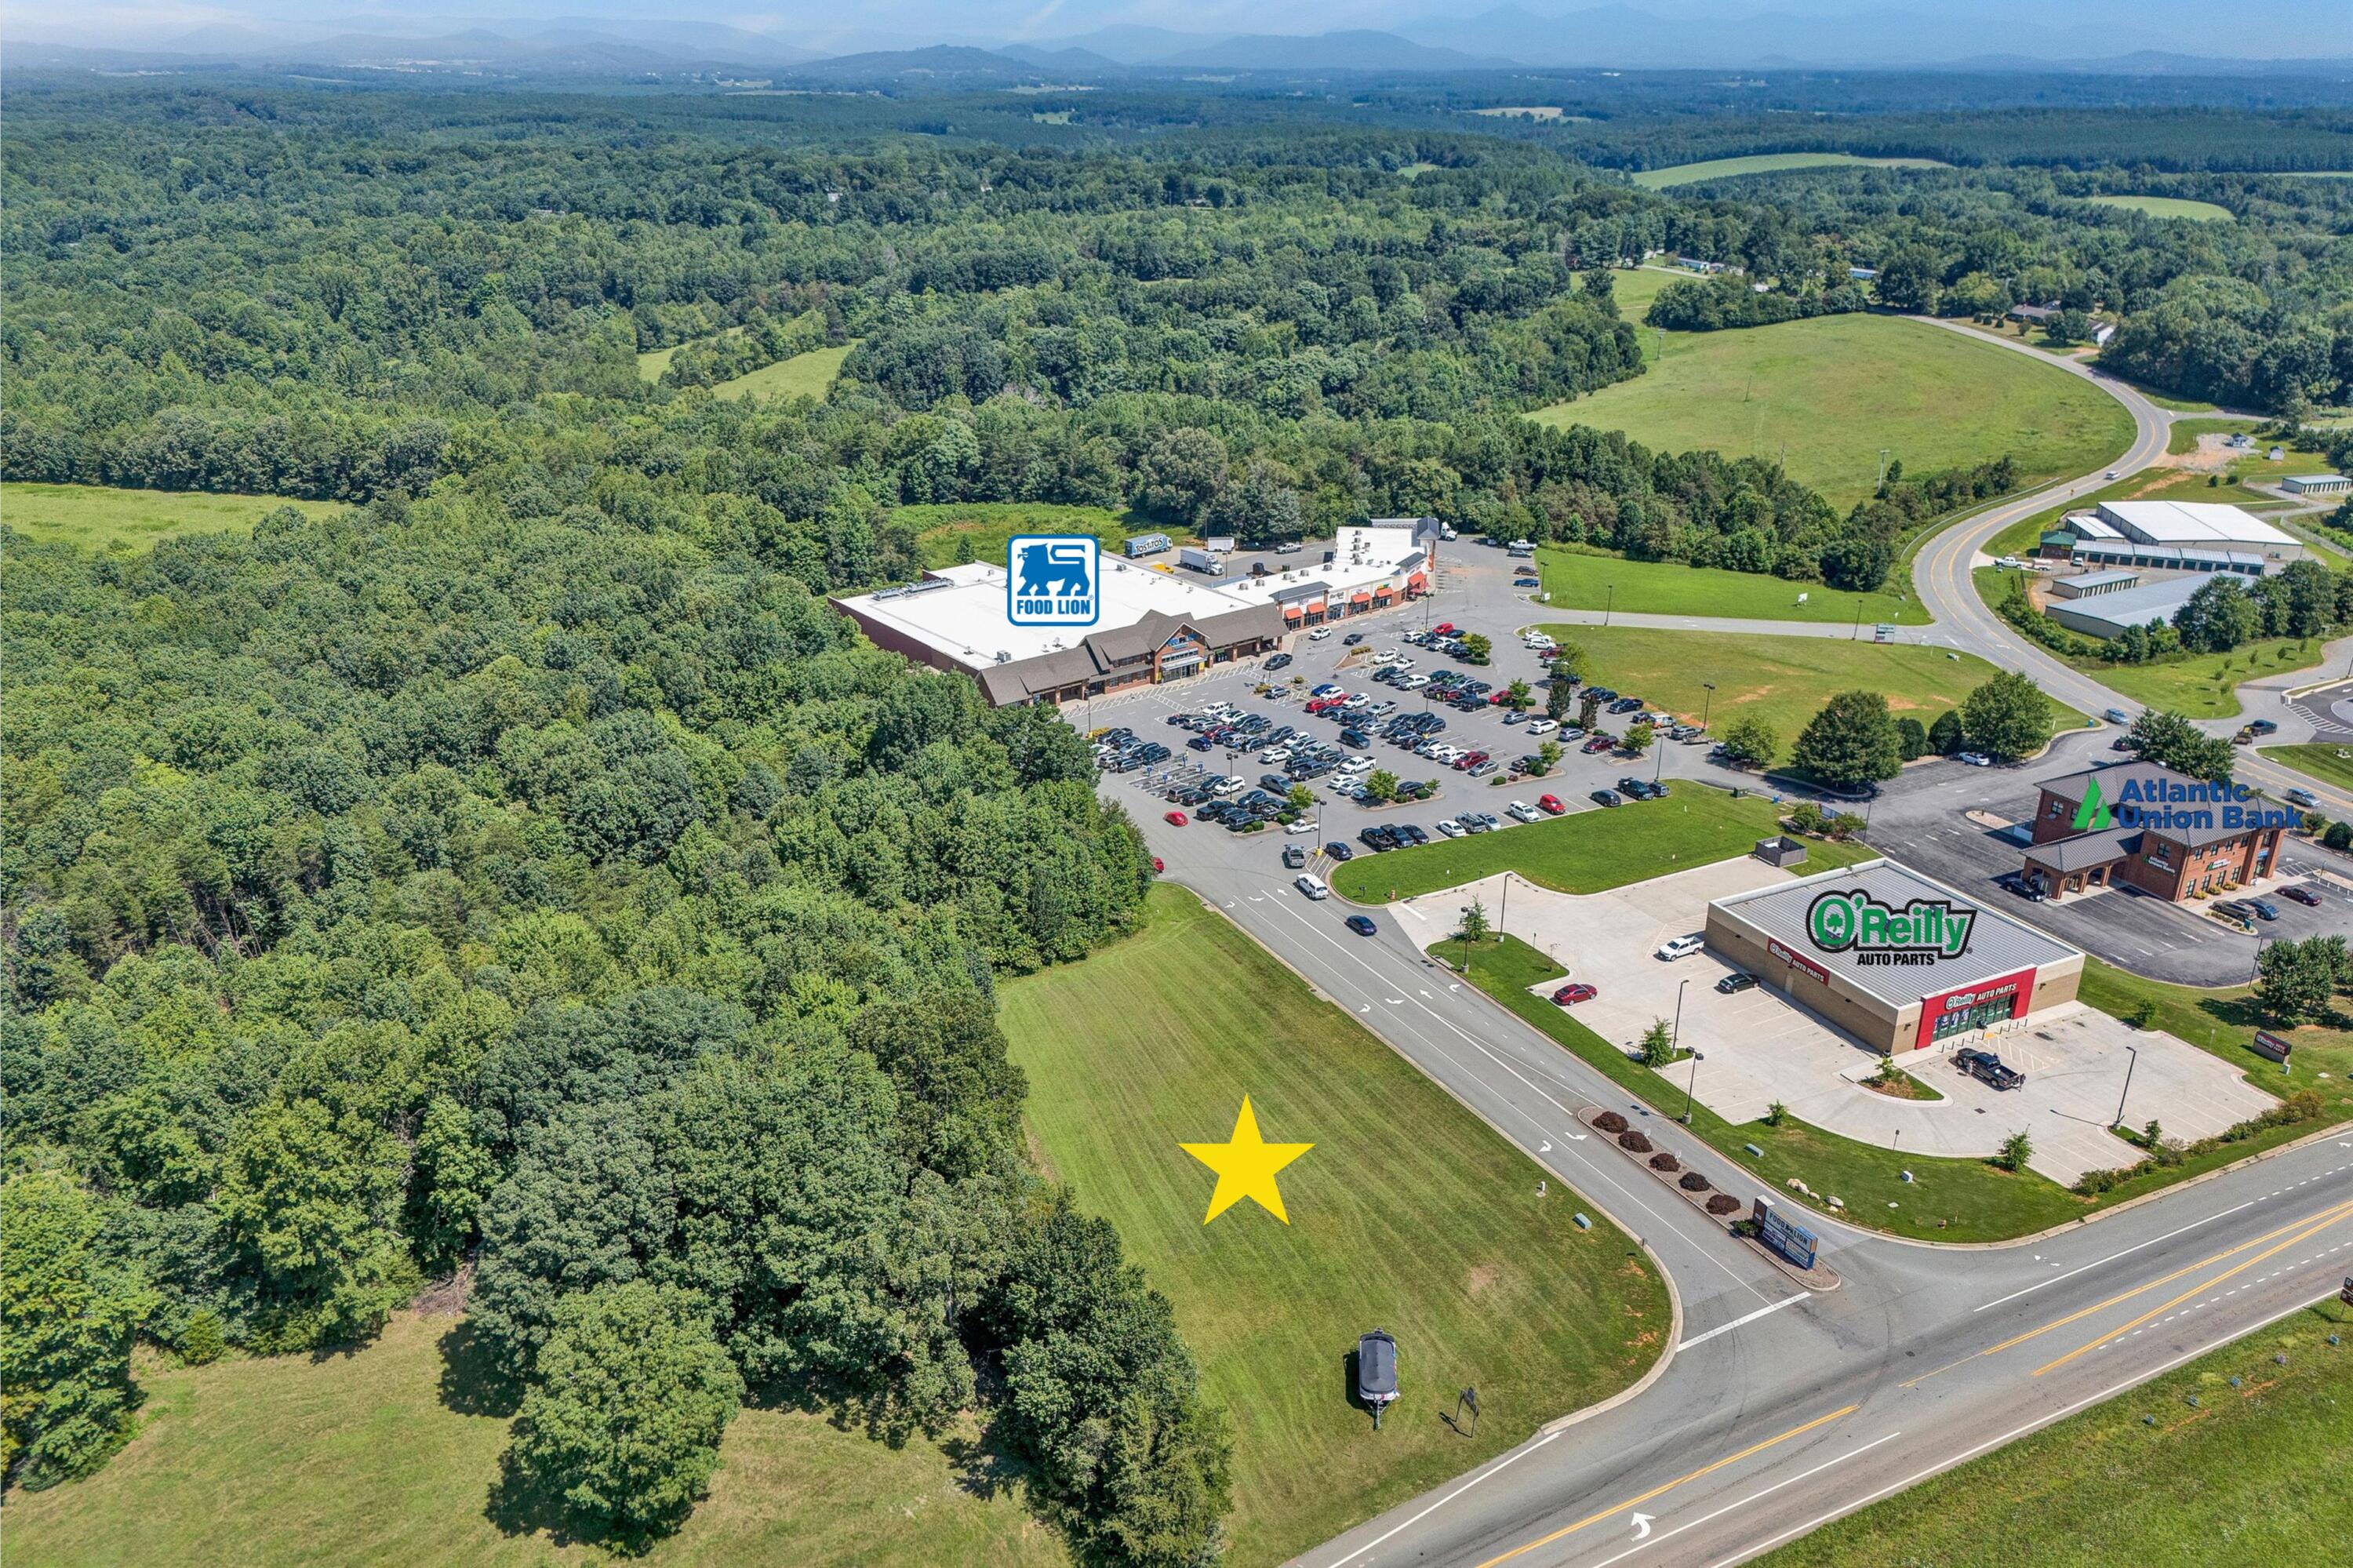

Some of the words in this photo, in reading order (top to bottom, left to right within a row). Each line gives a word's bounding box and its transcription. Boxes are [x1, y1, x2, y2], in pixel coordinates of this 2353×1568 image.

[1792, 959, 1806, 971] AUTO
[1806, 967, 1824, 982] PARTS
[1946, 992, 1976, 1010] O'Reilly
[1977, 989, 1995, 1001] AUTO
[1995, 983, 2017, 995] PARTS
[1769, 1213, 1785, 1228] FOOD
[1794, 1228, 1807, 1245] LION
